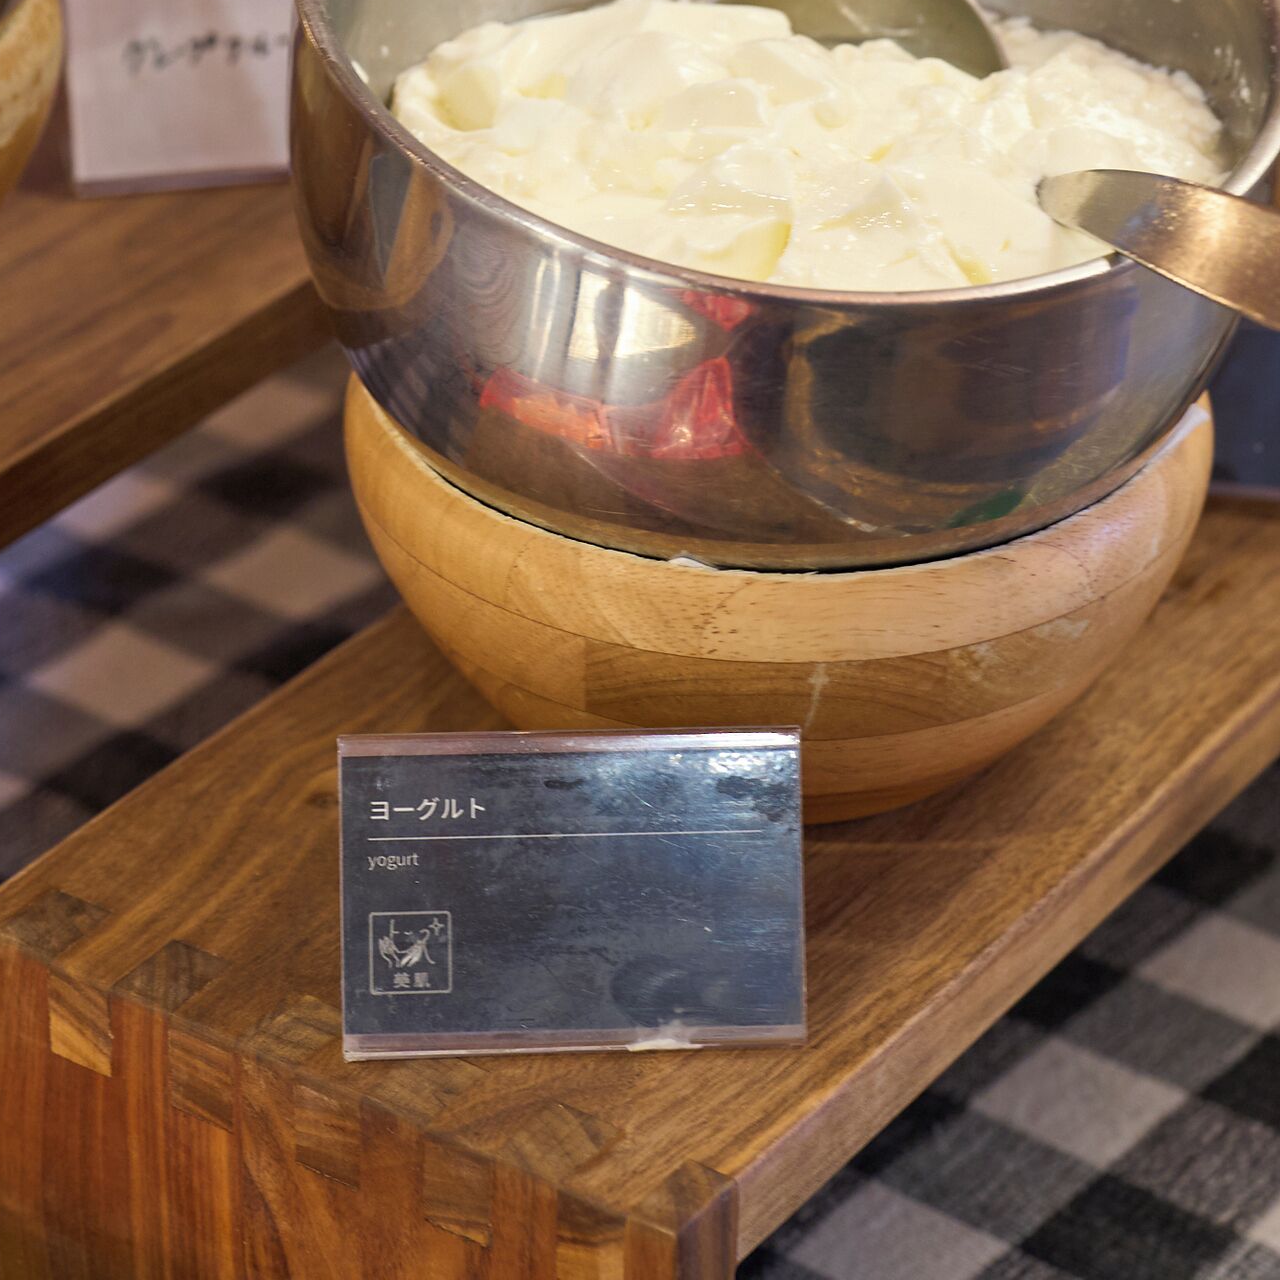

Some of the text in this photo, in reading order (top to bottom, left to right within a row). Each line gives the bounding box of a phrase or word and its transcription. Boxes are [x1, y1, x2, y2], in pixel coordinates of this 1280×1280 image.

[369, 797, 487, 821] ヨーグルト
[367, 852, 420, 871] yogurt
